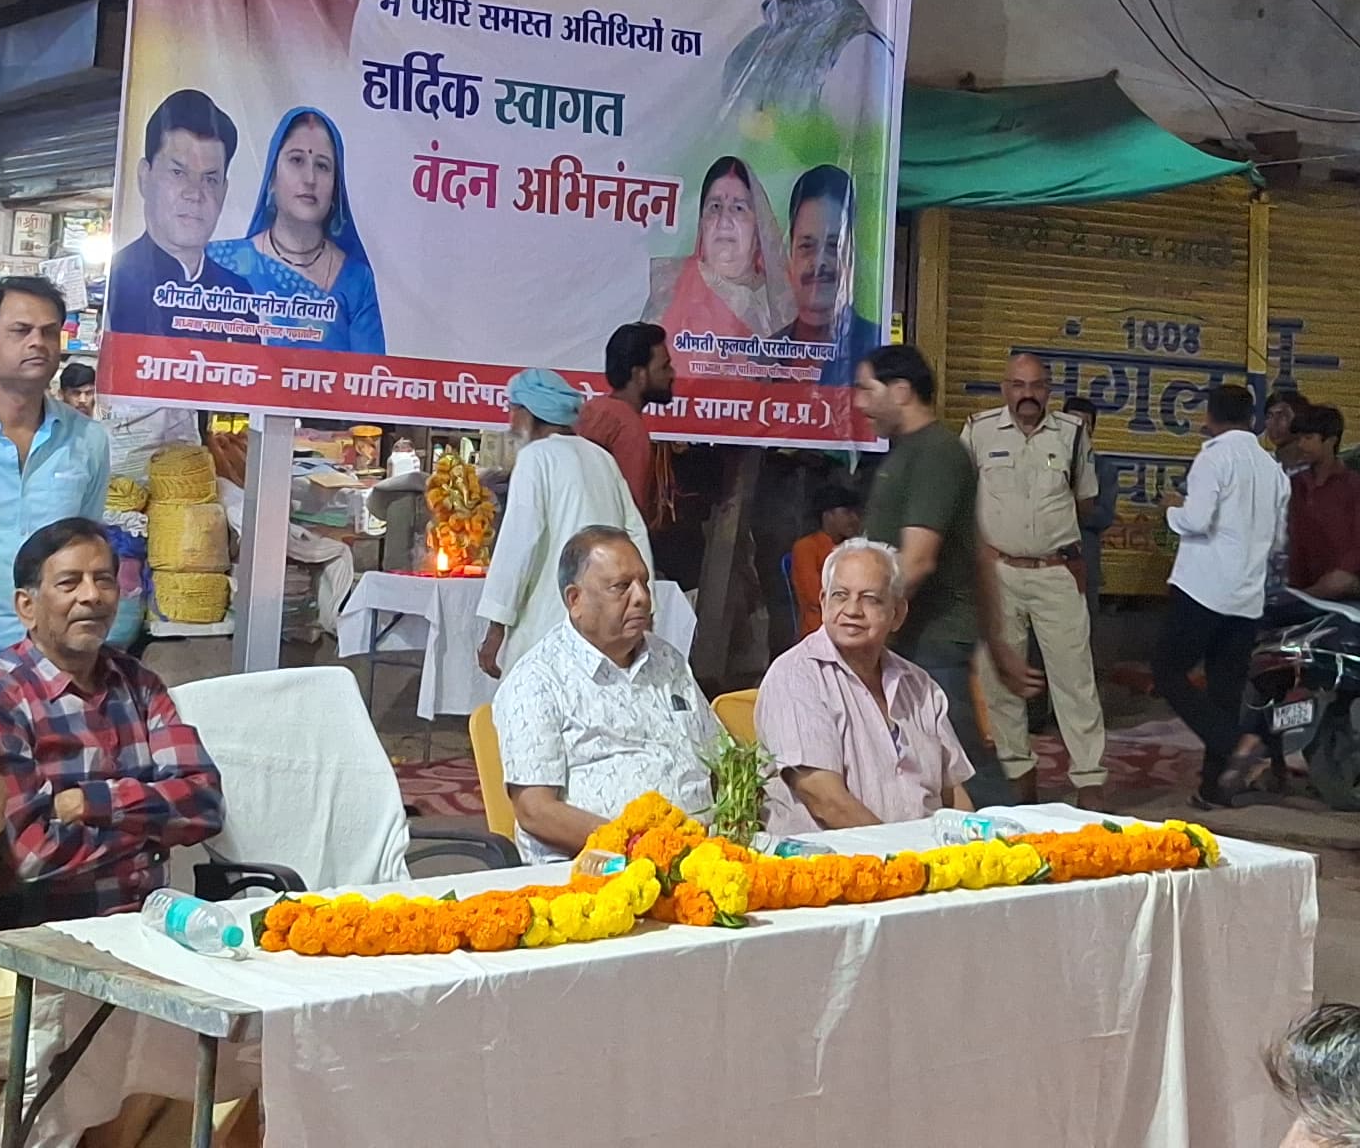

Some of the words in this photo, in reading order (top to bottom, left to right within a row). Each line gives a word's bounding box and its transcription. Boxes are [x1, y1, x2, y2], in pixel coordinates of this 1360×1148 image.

[478, 3, 552, 38] समस्त
[671, 28, 702, 57] का
[362, 51, 483, 120] हार्दिक
[494, 77, 626, 137] स्वागत
[413, 140, 500, 210] वंदन
[512, 154, 680, 227] अभिनंदन
[155, 282, 201, 308] श्रीमती
[205, 285, 249, 314] संगीता
[291, 295, 337, 321] तिवारी
[674, 332, 714, 353] श्रीमती
[1122, 317, 1201, 354] 1008
[136, 350, 272, 387] आयोजक-
[281, 366, 336, 394] नगर
[344, 364, 436, 402] पालिका
[694, 397, 753, 421] सागर
